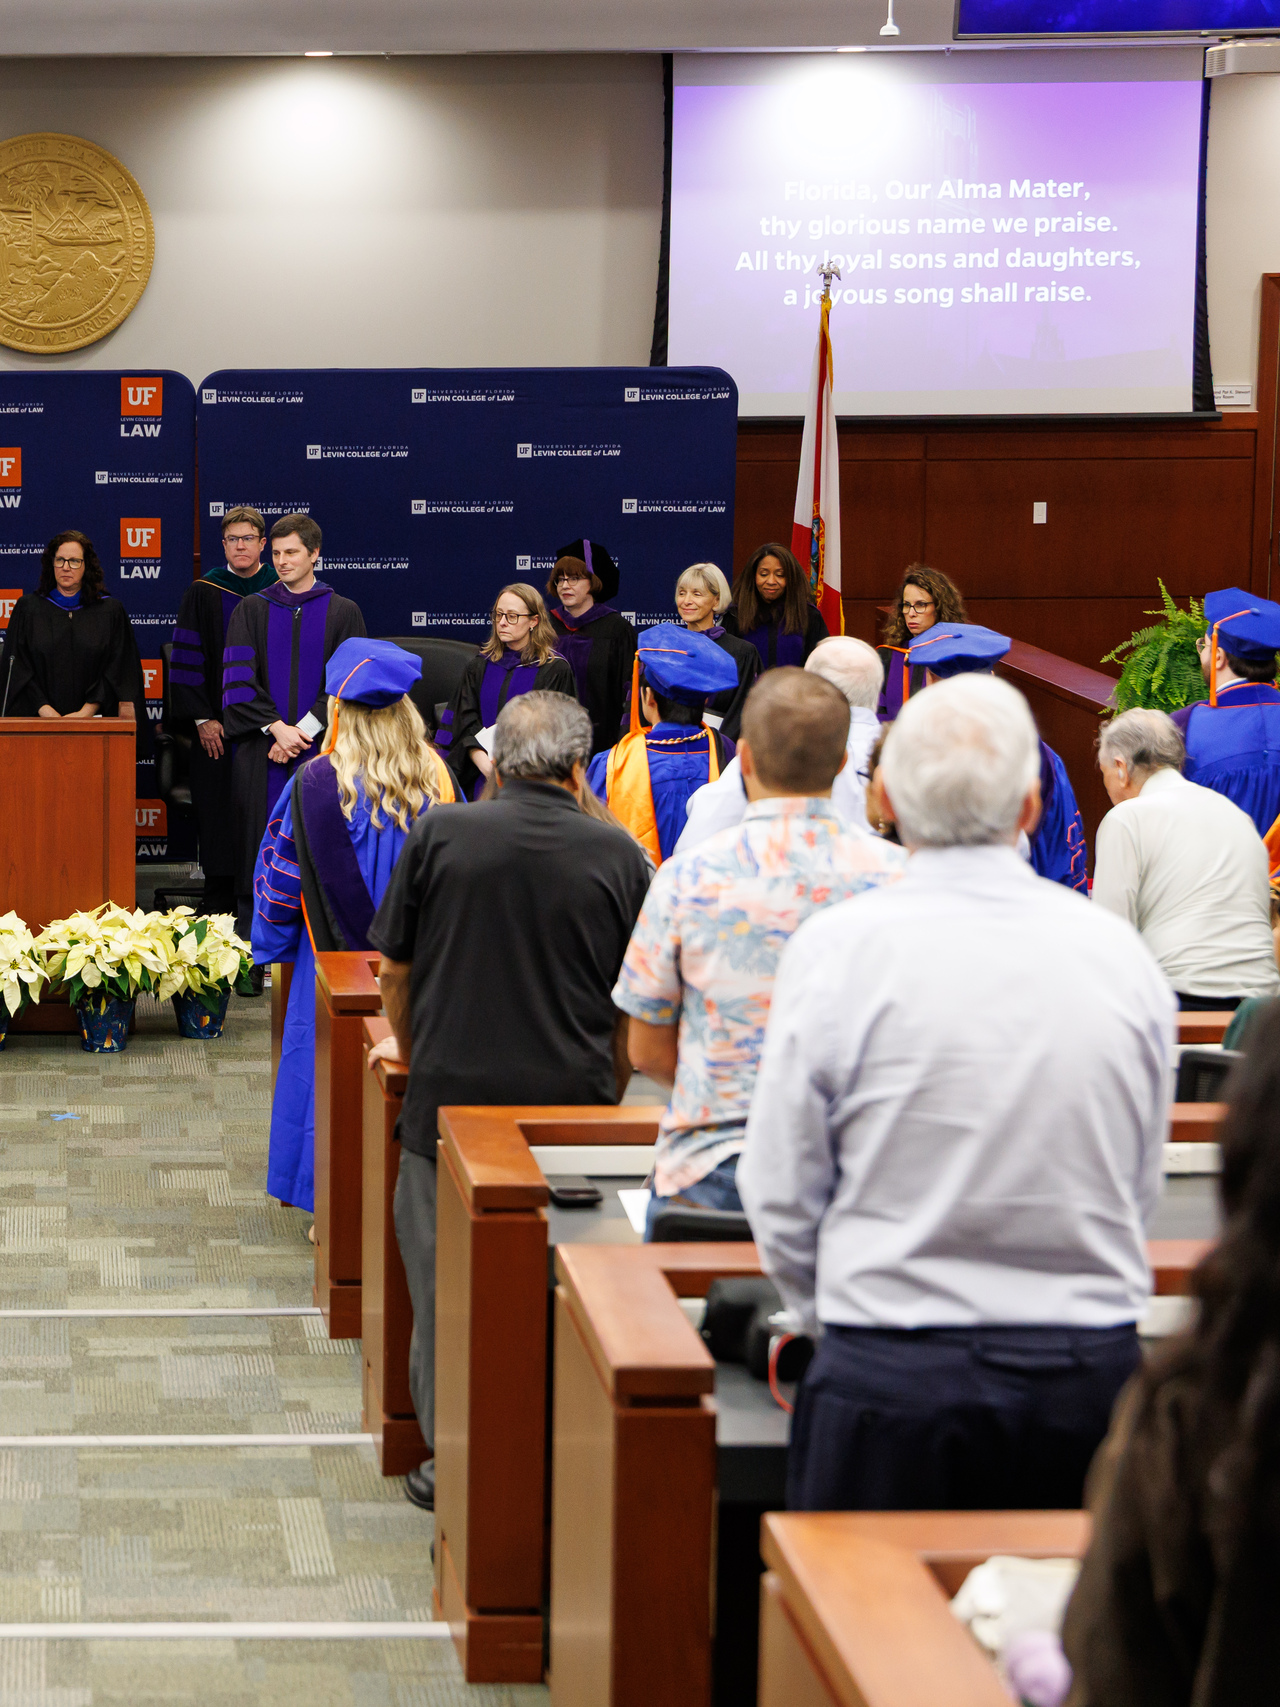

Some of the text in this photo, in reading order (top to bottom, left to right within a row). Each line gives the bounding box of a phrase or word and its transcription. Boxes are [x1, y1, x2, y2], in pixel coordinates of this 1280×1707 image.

[784, 179, 1090, 203] Florida, Our Alma Mater,
[8, 140, 47, 159] THE
[58, 142, 109, 174] STATE
[112, 176, 133, 197] OF
[124, 201, 147, 284] FLORIDA
[760, 211, 1118, 240] thy glorious name we praise.
[735, 247, 1141, 274] All thy loyal sons and daughters,
[783, 289, 797, 305] a
[894, 287, 953, 308] song
[961, 282, 1017, 303] shall
[1024, 281, 1091, 302] raise.
[3, 324, 35, 343] GOD
[40, 330, 69, 345] WE
[72, 304, 118, 339] TRUST
[128, 387, 156, 405] UF
[121, 424, 161, 437] LAW
[127, 528, 155, 547] UF
[121, 566, 161, 578] LAW
[135, 809, 161, 827] UF
[135, 844, 167, 856] AW
